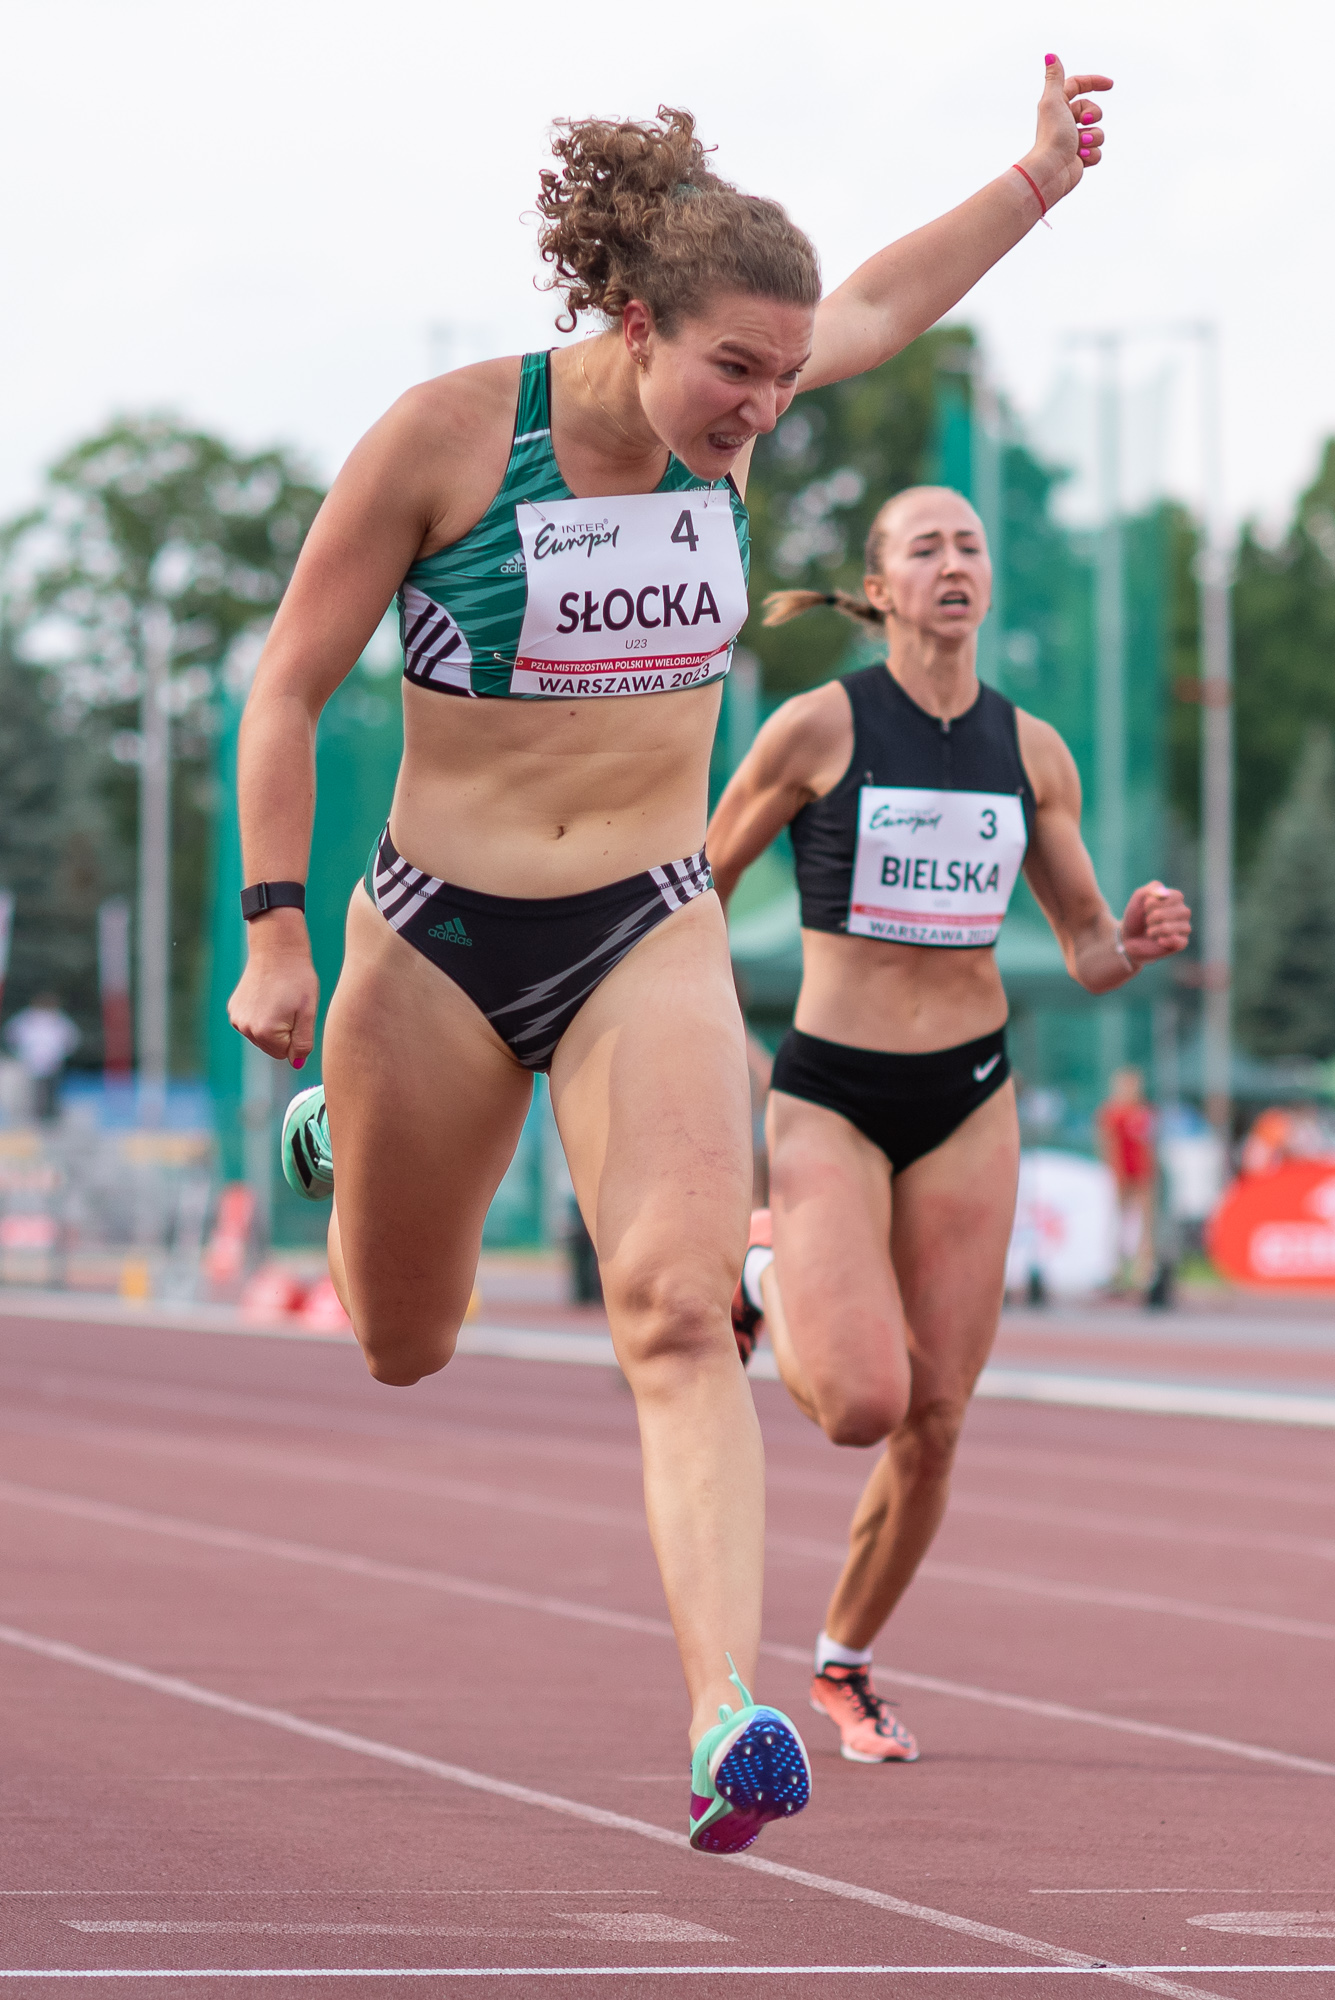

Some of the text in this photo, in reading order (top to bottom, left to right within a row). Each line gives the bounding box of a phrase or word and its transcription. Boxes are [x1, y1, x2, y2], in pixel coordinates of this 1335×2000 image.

[534, 523, 620, 560] Europol
[671, 510, 699, 552] 4
[556, 582, 721, 634] SŁOCKA
[625, 639, 648, 650] U23
[531, 661, 552, 671] PZLA
[553, 661, 614, 672] MISTRZOSTWA
[615, 660, 643, 670] POLSKI
[645, 659, 654, 668] W
[538, 663, 710, 694] WARSZAWA 2023
[979, 809, 998, 840] 3
[880, 856, 1000, 893] BIELSKA
[428, 928, 473, 947] adidas
[870, 921, 963, 942] WARSZAWA
